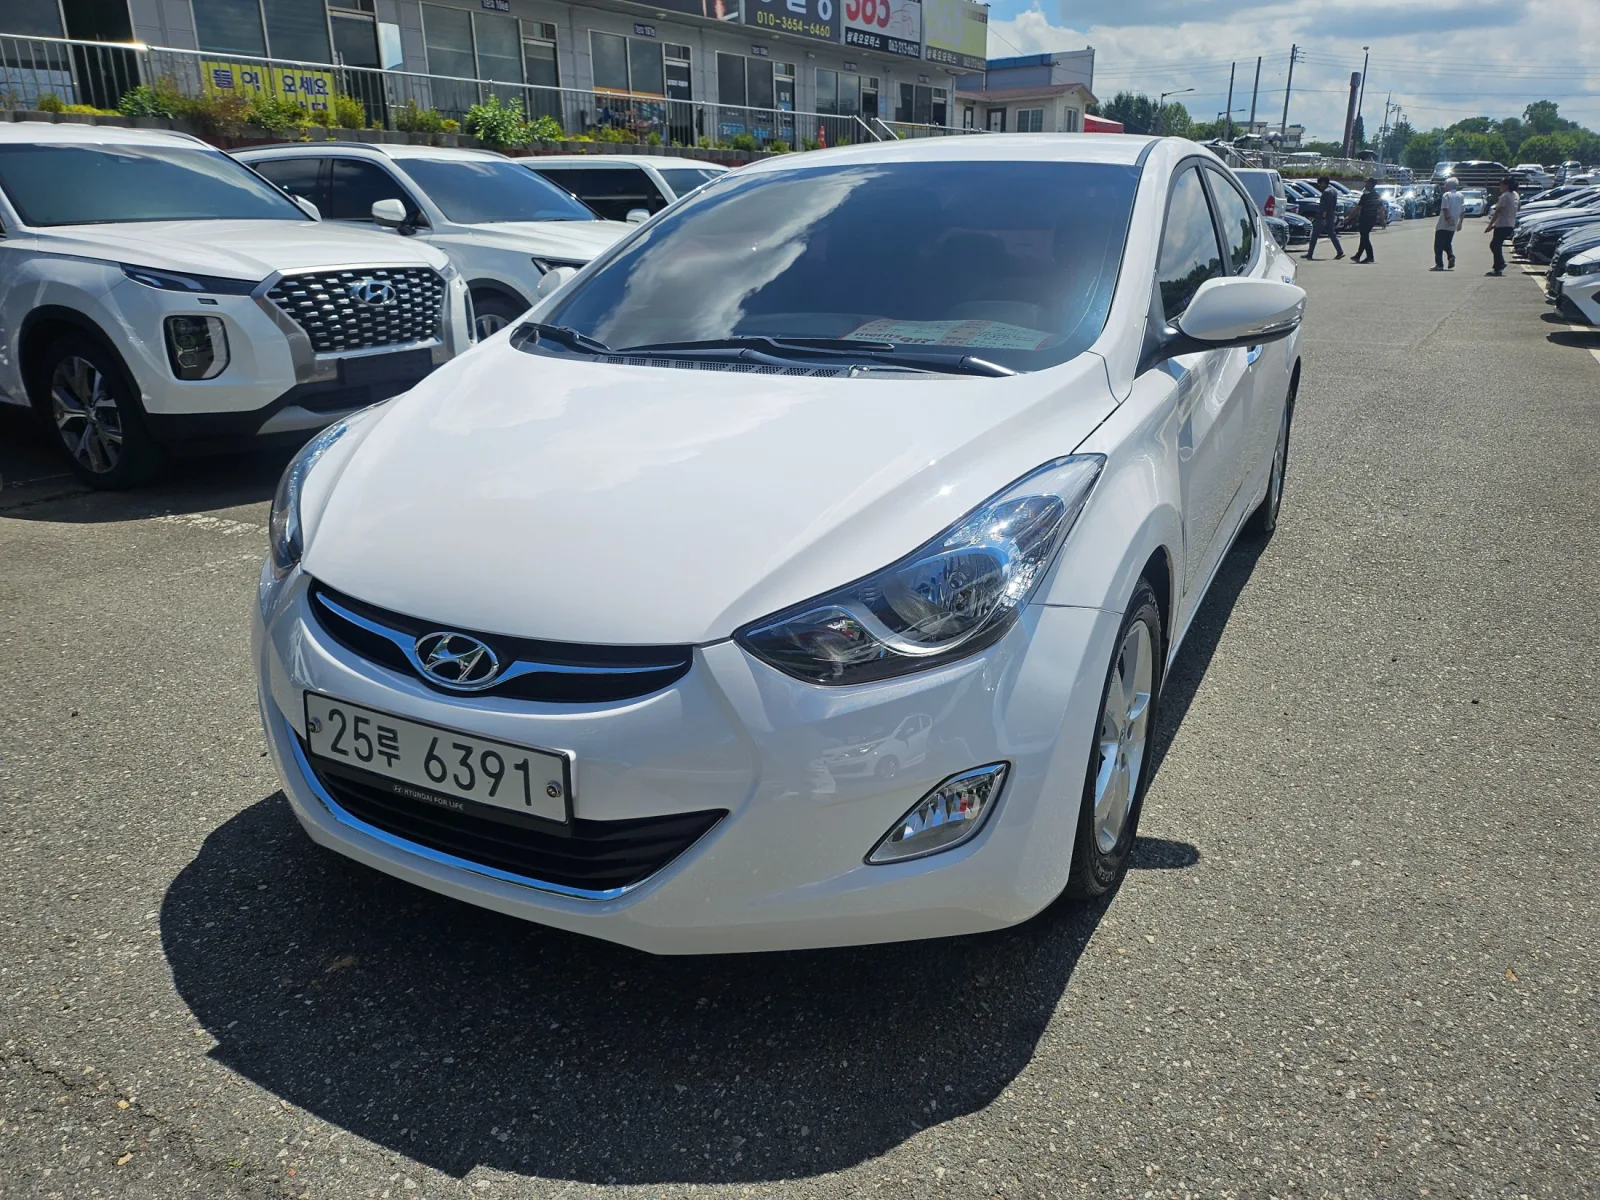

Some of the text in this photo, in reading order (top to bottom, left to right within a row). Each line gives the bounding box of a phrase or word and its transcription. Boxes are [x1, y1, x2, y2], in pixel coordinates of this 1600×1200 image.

[757, 11, 831, 38] 010-3654-6460
[282, 74, 330, 96] 오세요
[328, 708, 532, 807] 25루 6391
[404, 788, 464, 811] HYUNDAI FOR LIFE
